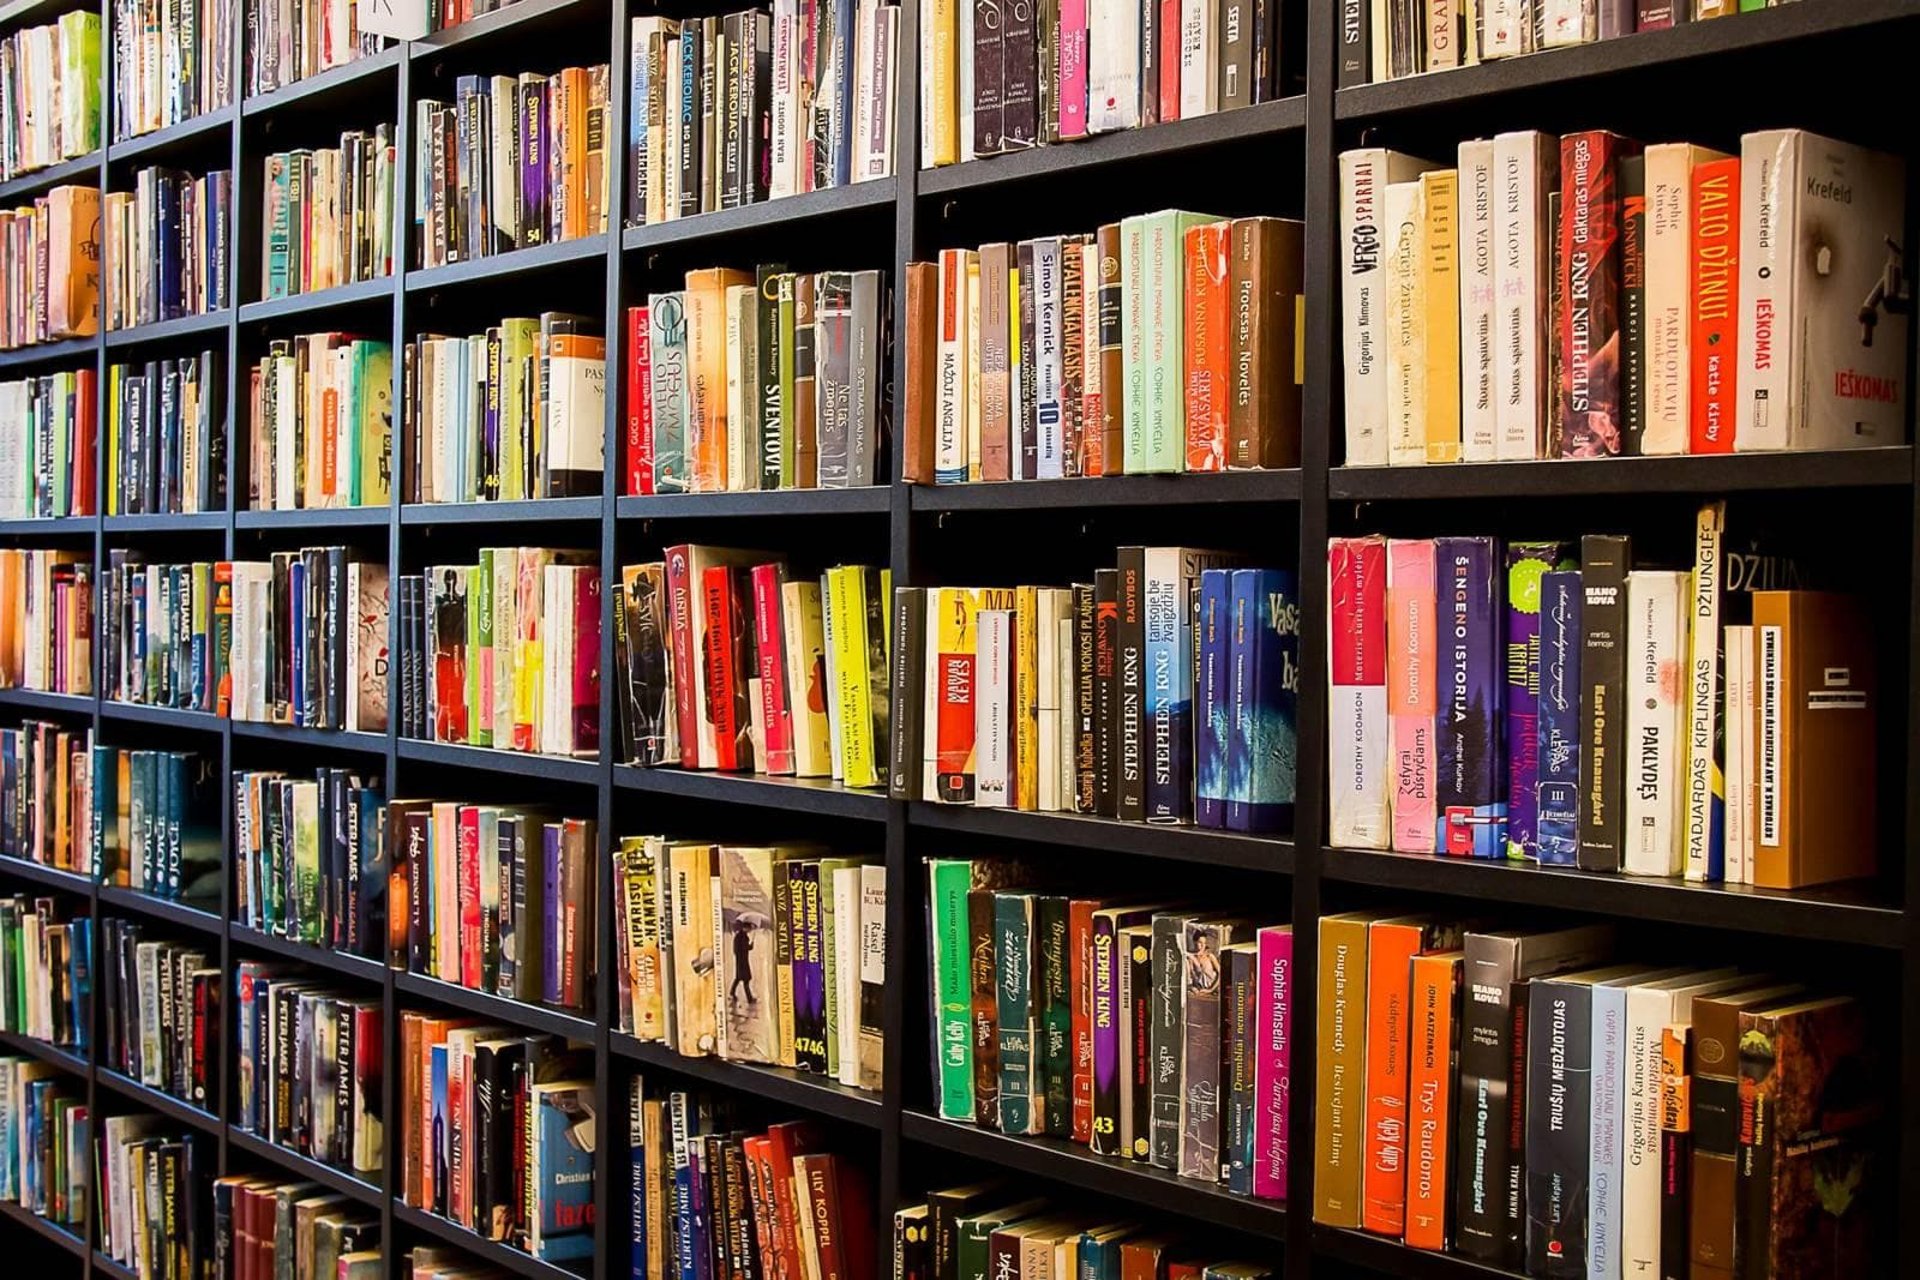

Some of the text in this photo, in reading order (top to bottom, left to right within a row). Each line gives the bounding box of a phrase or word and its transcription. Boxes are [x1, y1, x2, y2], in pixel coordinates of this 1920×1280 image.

[682, 31, 694, 123] JACK KEROUAC
[728, 40, 740, 140] JACK KEROUAC
[1063, 31, 1074, 81] VERSACE
[527, 96, 540, 166] STEPHEN KING
[777, 100, 786, 163] DEAN KOONTZ
[434, 123, 444, 247] FRANZ KAFKA
[1352, 163, 1380, 275] VERGO SPARNAI
[1475, 163, 1488, 275] AGOTA KRISTOF
[1507, 155, 1519, 269] AGOTA KRISTOF
[1571, 139, 1591, 243] daktaras miegas
[1654, 184, 1683, 236] Sophie Kinsella
[1806, 177, 1852, 205] Krefeld
[1623, 196, 1647, 289] KONWICKI
[1698, 175, 1737, 321] VALIO DŽINUI
[1759, 204, 1771, 248] Krefeld
[1041, 255, 1055, 355] Simon Kernick
[1195, 302, 1206, 365] SUSANNA
[1238, 280, 1253, 346] Procesas.
[1358, 287, 1373, 375] Grigorijus Klimovas
[1571, 251, 1589, 411] STEPHEN KING
[1755, 298, 1776, 371] IEŠKOMAS
[943, 353, 958, 397] MAŽOJI
[1475, 312, 1491, 410] Storas sąsiuvinis
[1508, 306, 1523, 405] Storas sąsiuvinis
[1663, 307, 1680, 422] PARDUOTUVIŲ
[630, 416, 638, 445] GUCCI
[824, 379, 838, 433] žmogus
[837, 384, 850, 427] Ne tas
[941, 399, 953, 451] ANGLIJA
[1021, 401, 1030, 433] KNYGA
[1038, 399, 1060, 425] 10
[1131, 369, 1141, 454] SOPHIE KINSELLA
[1152, 366, 1163, 454] SOPHIE KINSELLA
[1705, 355, 1720, 442] Katie Kirby
[1126, 569, 1136, 624] RADYBOS
[1147, 596, 1167, 643] tamsoje
[1585, 587, 1617, 606] MANO KOVA
[1097, 601, 1118, 677] KONWICKI
[1406, 600, 1420, 704] Dorothy Koomson
[1454, 556, 1471, 722] ŠENGENO ISTORIJA
[1644, 641, 1657, 684] Krefeld
[762, 655, 778, 729] Profesorius
[955, 659, 971, 704] KEYES
[1124, 647, 1138, 781] STEPHEN KING
[1155, 649, 1171, 785] STEPHEN KING
[1593, 684, 1604, 745] Karl Ove
[1080, 733, 1094, 807] Susanna Kubelka
[1354, 692, 1364, 791] DOROTHY KOOMSON
[1455, 733, 1465, 793] Andrei Kurkov
[1549, 728, 1563, 772] KLEYPAS
[1637, 726, 1659, 800] PAKLYDĘS
[1690, 659, 1711, 859] RADJARDAS KIPLINGAS
[93, 811, 102, 864] JOYCE
[143, 814, 153, 867] JOYCE
[156, 815, 166, 870] JOYCE
[168, 821, 180, 875] JOYCE
[348, 802, 358, 881] PETER JAMES
[777, 883, 791, 1014] KINGAS TYLOS ZONA
[789, 879, 804, 961] STEPHEN KING
[805, 880, 819, 963] STEPHEN KING
[869, 921, 881, 954] Rasel
[1094, 933, 1111, 1028] STEPHEN KING
[1271, 958, 1288, 1051] Sophie Kinsella
[1330, 945, 1349, 1055] Douglas Kennedy
[1472, 984, 1502, 1004] MANO KOVA
[278, 1000, 289, 1075] PETER JAMES
[338, 1012, 349, 1106] PETER JAMES
[945, 1020, 968, 1041] Kelly
[1233, 982, 1246, 1092] Drambliai nematomi
[1386, 1046, 1398, 1076] Senos
[1424, 984, 1437, 1068] JOHN KATZENBACH
[1548, 1000, 1567, 1131] TRIUŠIŲ MEDŽIOTOJAS
[1629, 1026, 1646, 1166] Grigorijus Kanovičius
[670, 1092, 688, 1166] BE LIKIMO
[1374, 1116, 1405, 1172] Cathy Kelly
[1419, 1080, 1438, 1199] Trys Raudonos
[1476, 1079, 1490, 1136] Karl Ove
[1646, 1097, 1659, 1154] romansas
[165, 1156, 175, 1235] PETER JAMES
[811, 1170, 832, 1249] LILY KOPPEL
[1508, 1165, 1520, 1218] HANNA KRALL
[1551, 1173, 1562, 1223] Lars Kepler
[1593, 1172, 1608, 1274] SOPHIE KINSELLA
